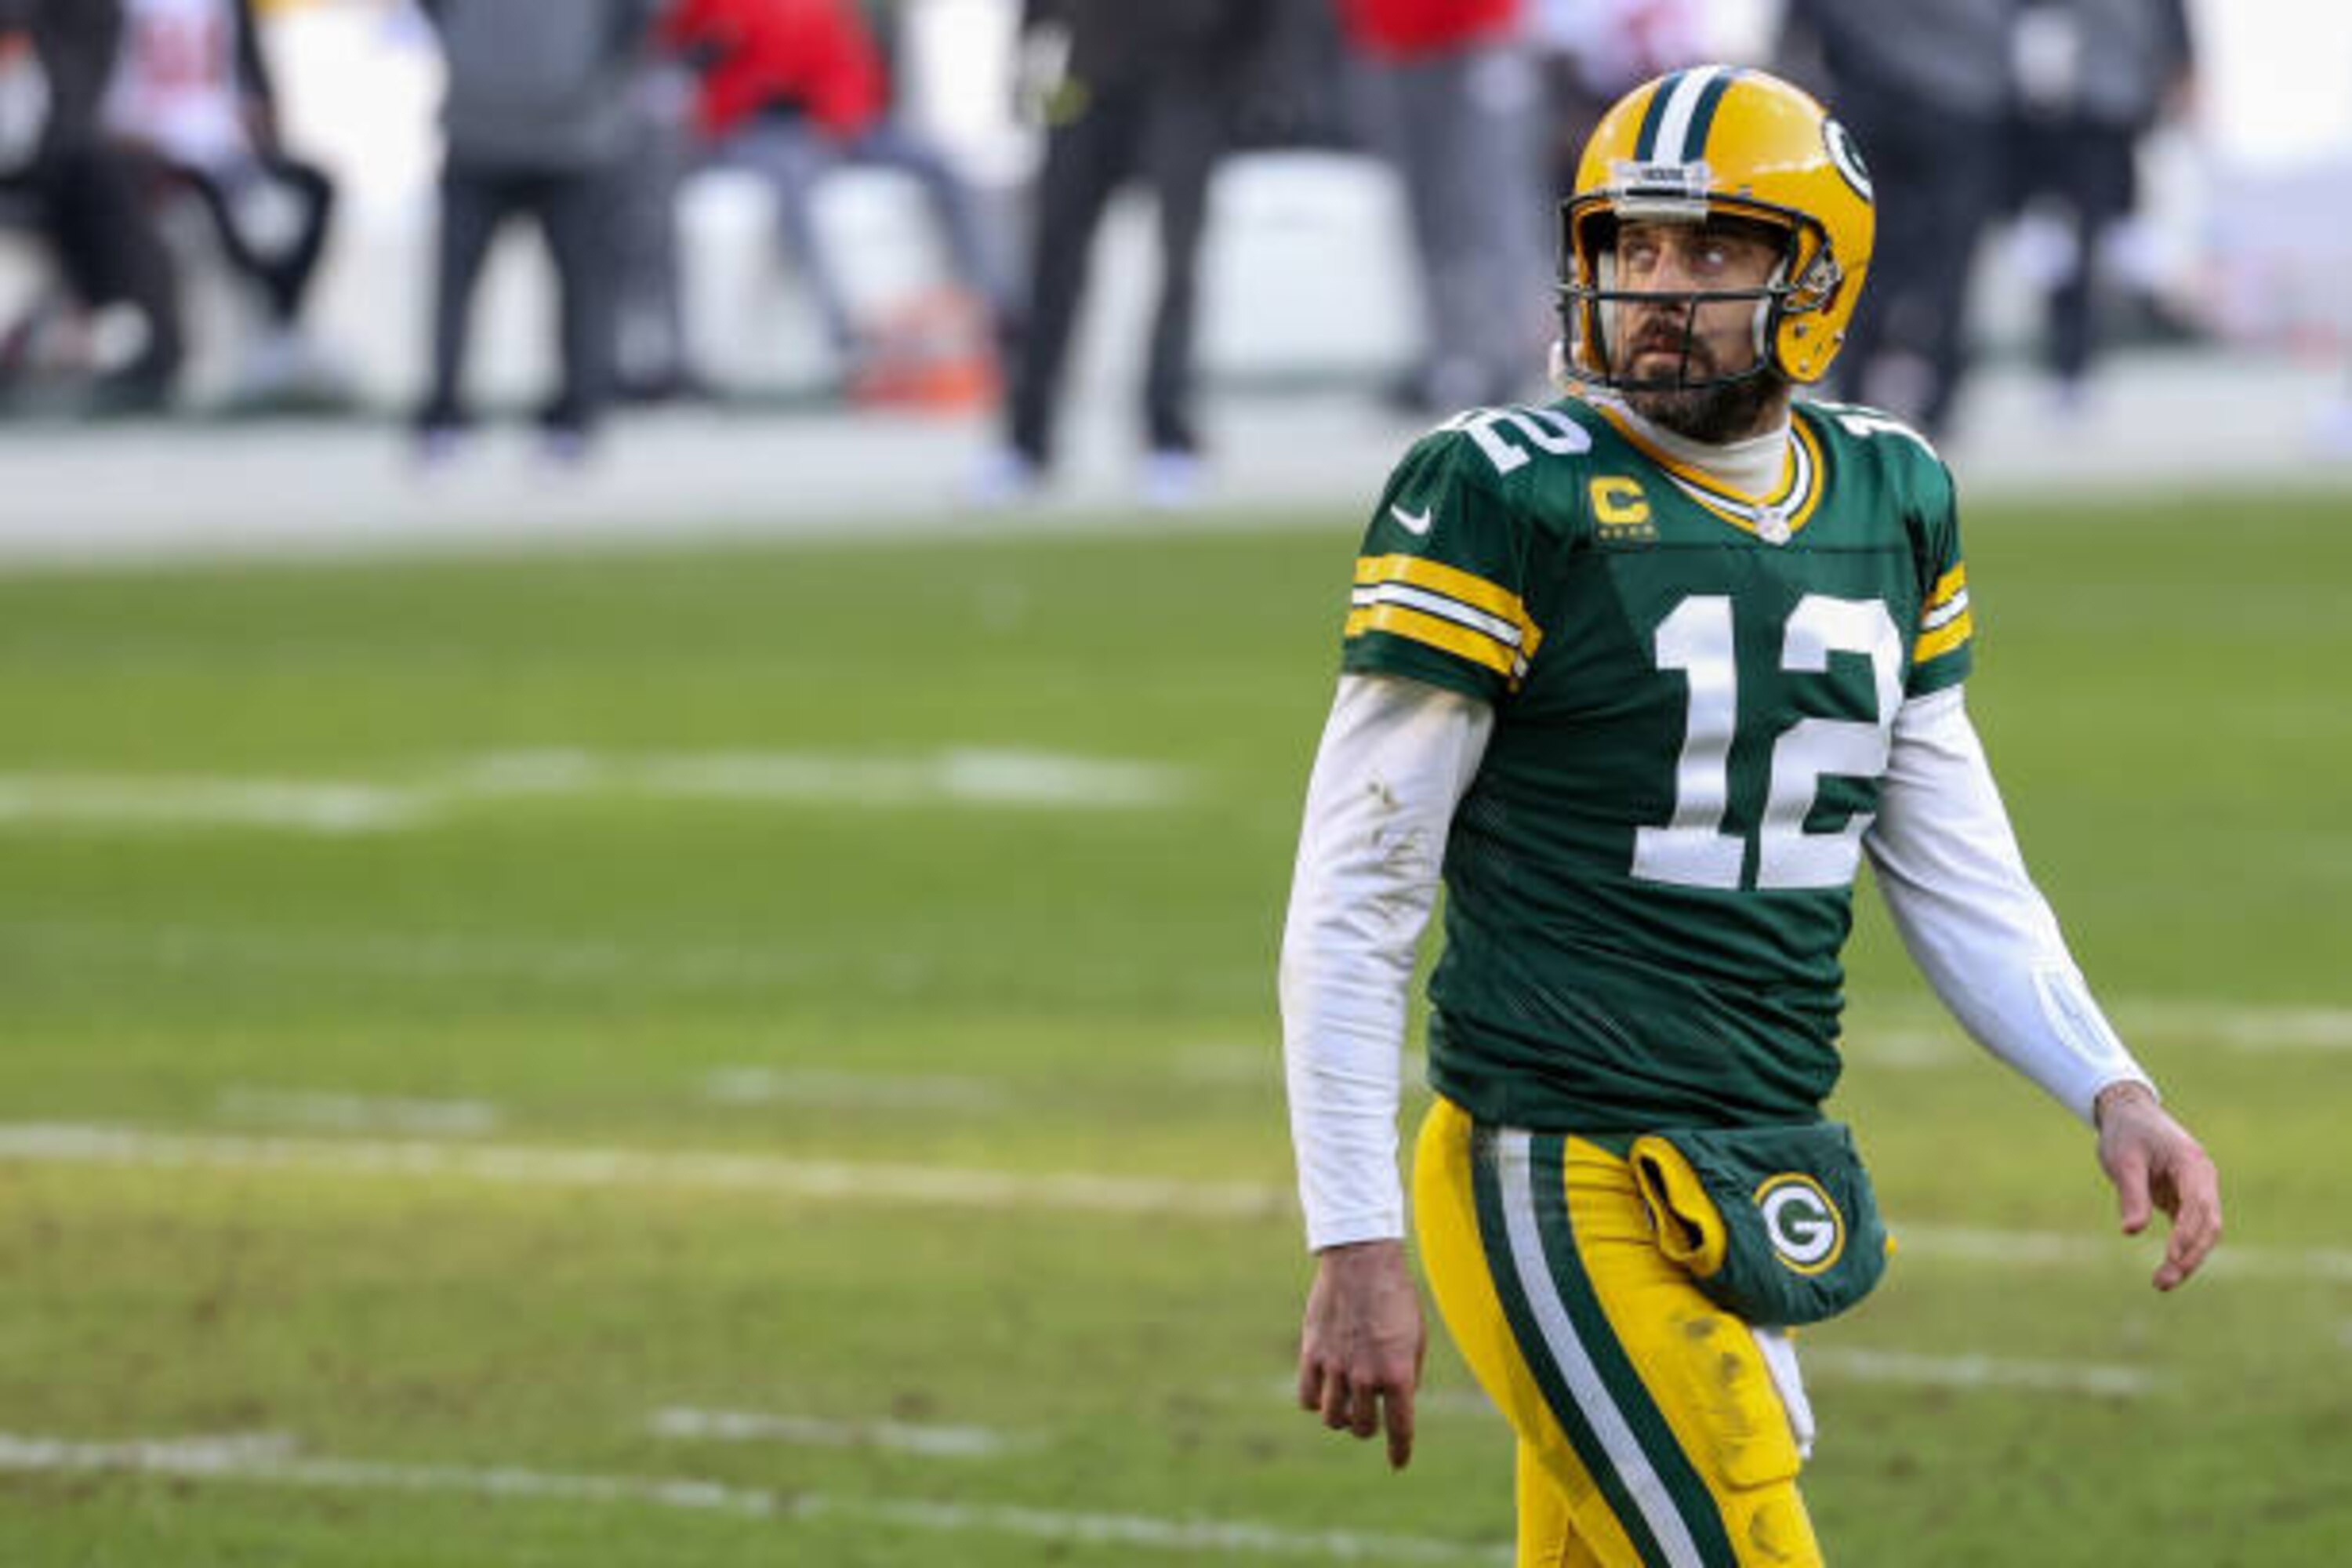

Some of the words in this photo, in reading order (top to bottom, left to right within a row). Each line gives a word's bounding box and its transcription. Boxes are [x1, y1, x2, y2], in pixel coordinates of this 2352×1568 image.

[1590, 476, 1650, 524] C
[1630, 593, 1904, 890] 12
[1762, 1185, 1835, 1263] G
